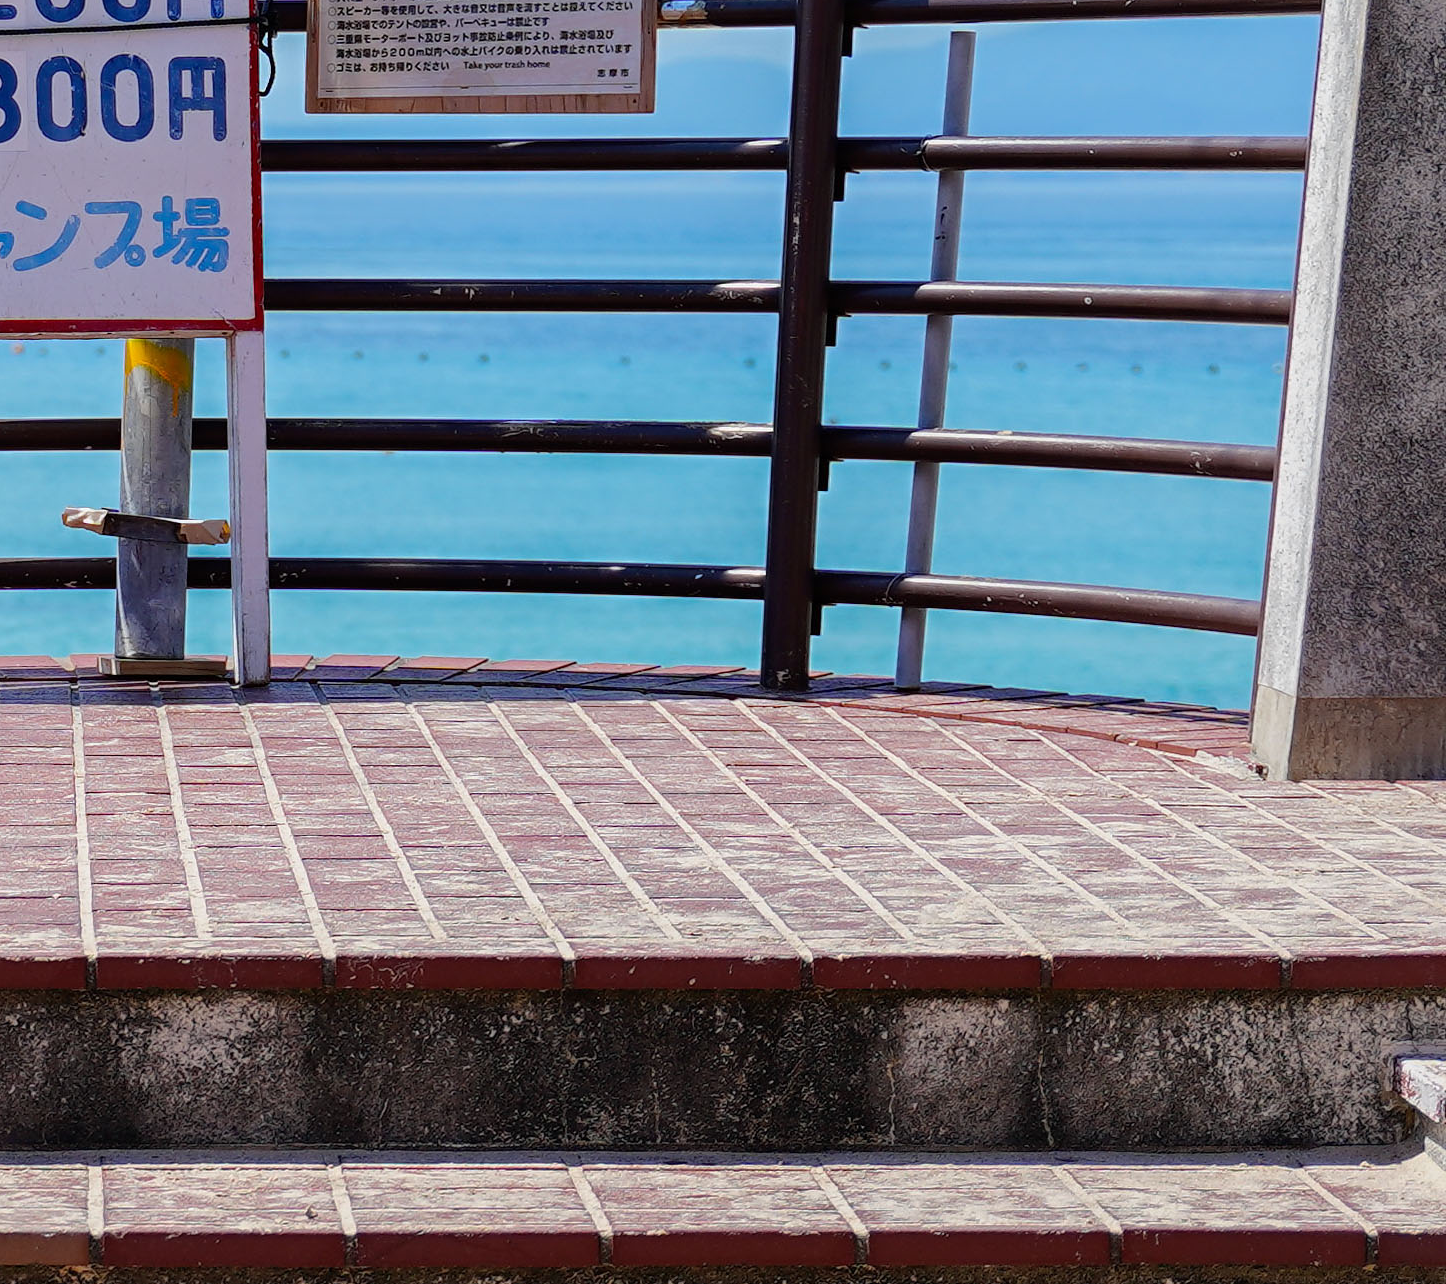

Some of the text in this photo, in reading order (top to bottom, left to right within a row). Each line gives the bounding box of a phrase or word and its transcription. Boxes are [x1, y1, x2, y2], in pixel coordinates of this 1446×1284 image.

[464, 61, 483, 70] Take
[484, 62, 503, 71] your
[504, 60, 526, 69] trash
[527, 60, 551, 68] home
